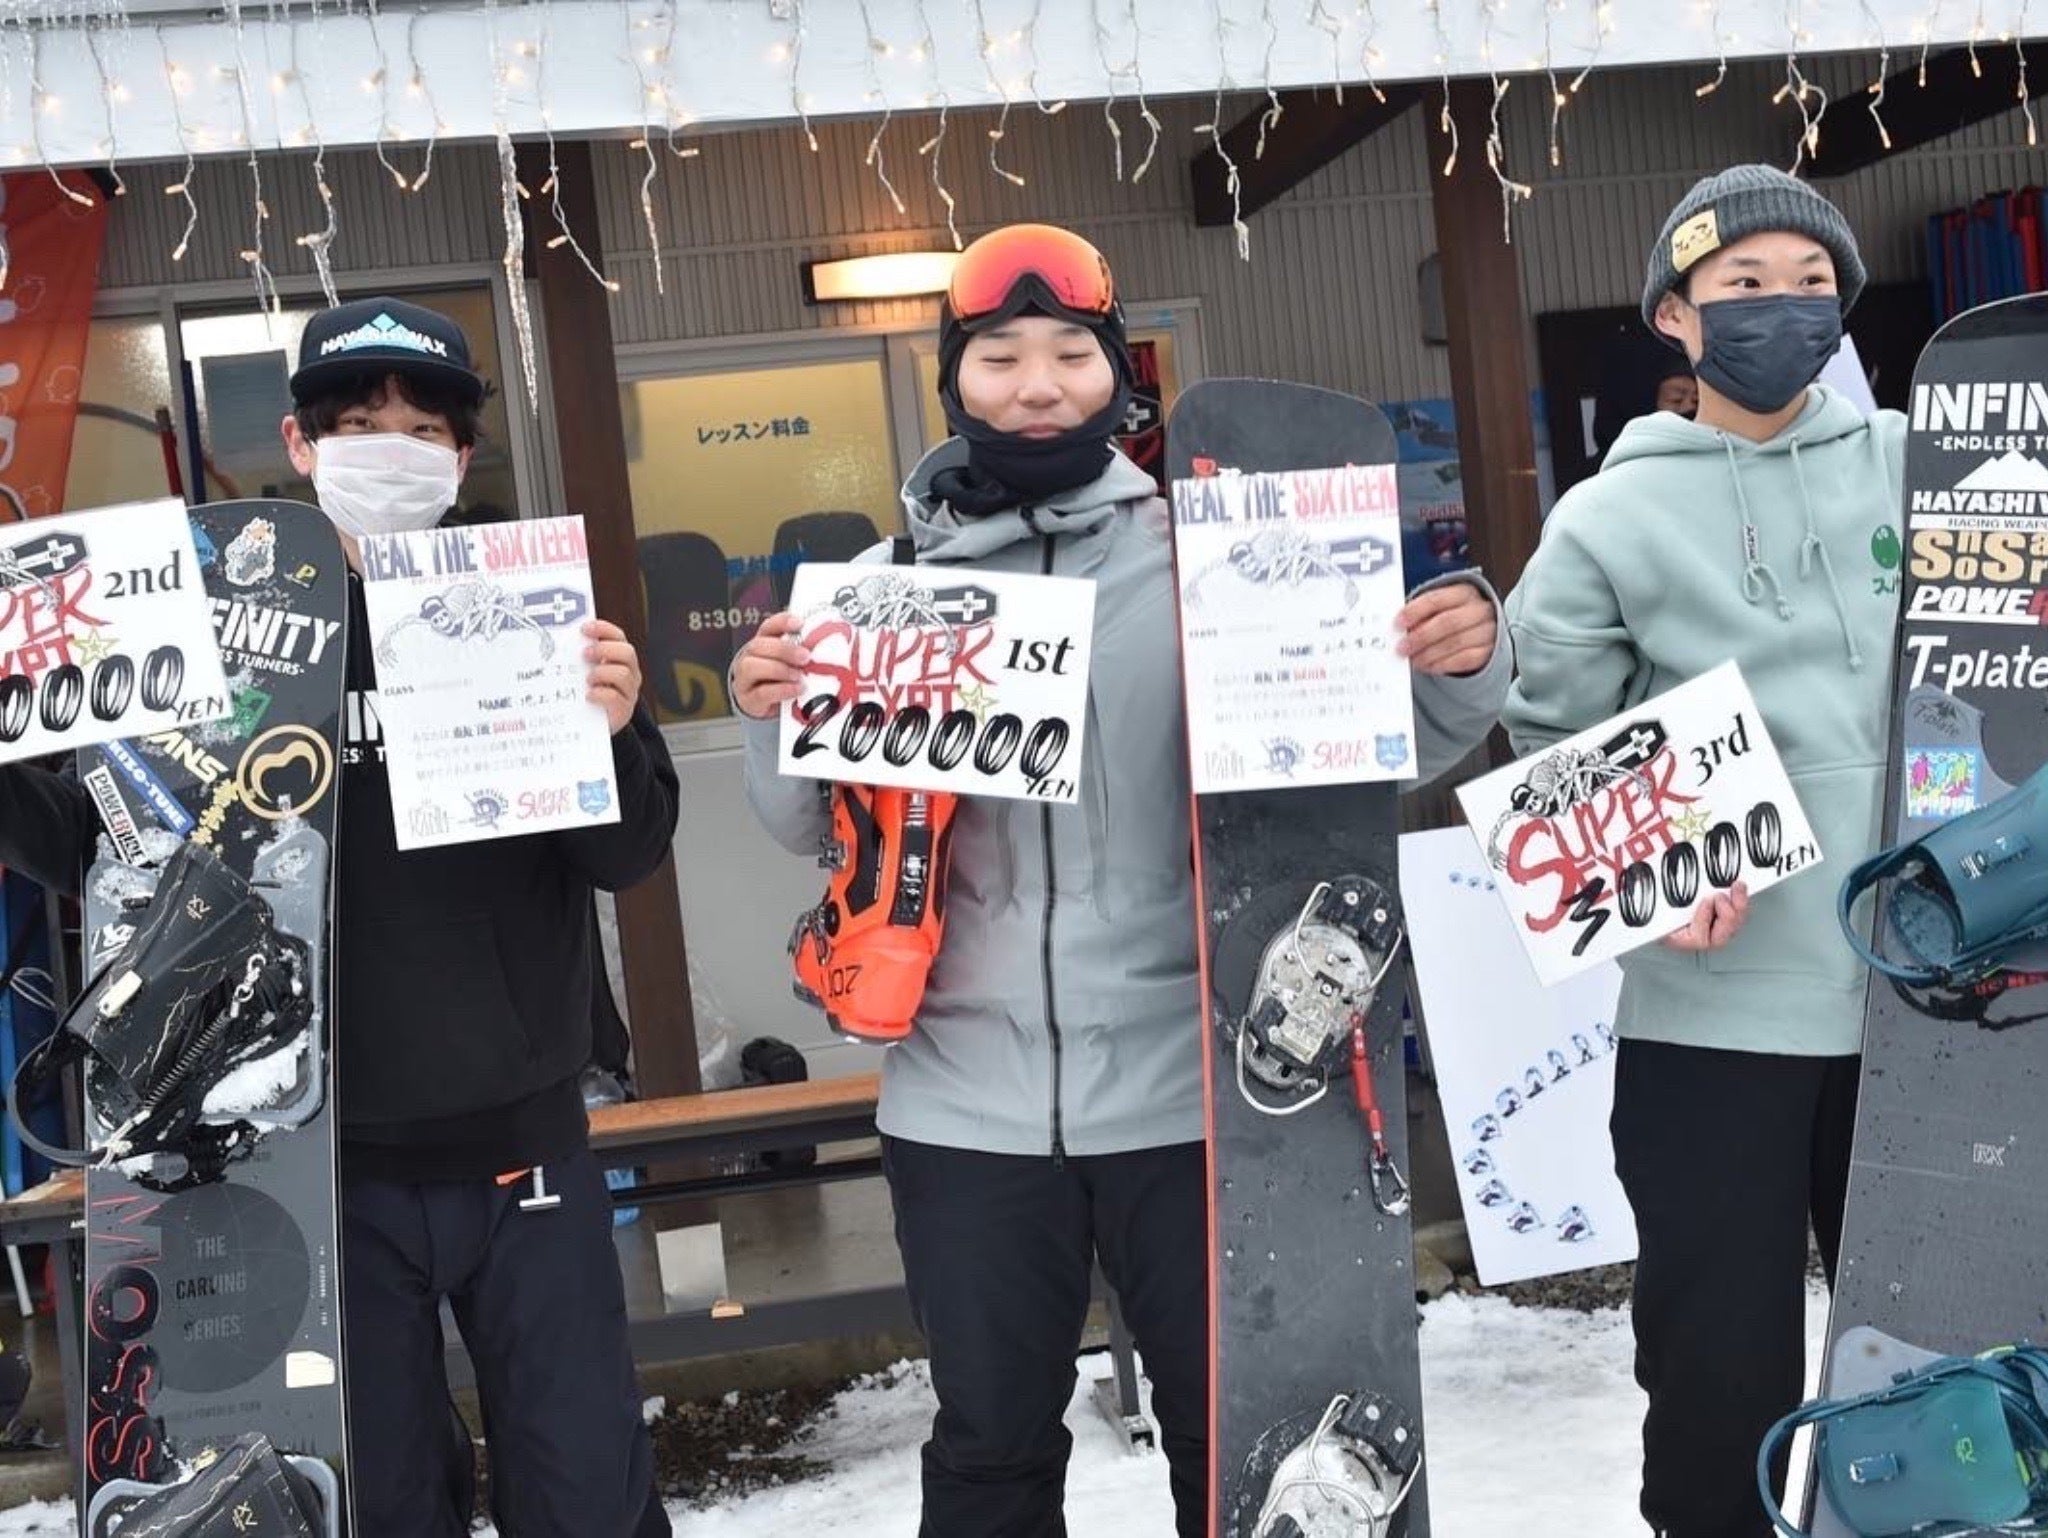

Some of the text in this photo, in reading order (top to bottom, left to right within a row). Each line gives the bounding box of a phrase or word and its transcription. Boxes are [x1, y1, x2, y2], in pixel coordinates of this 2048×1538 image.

[697, 416, 811, 444] レッスン料金
[1243, 472, 1287, 520] THE
[1293, 468, 1398, 519] SIXTEEN
[1949, 517, 1999, 529] RACING
[104, 549, 182, 599] 2nd
[364, 532, 422, 582] REAL
[426, 525, 478, 575] THE
[482, 522, 588, 571] SIXTEEN
[791, 620, 999, 726] SUPER
[1003, 636, 1075, 676] 1st
[170, 697, 225, 723] YEN
[791, 693, 1074, 799] 200000 YEN
[1691, 713, 1751, 786] 3rd
[1507, 746, 1704, 933] SUPER
[1563, 801, 1815, 956] 30000 YEN
[196, 1234, 227, 1259] THE
[176, 1270, 247, 1300] CARVING
[183, 1315, 241, 1342] SERIES
